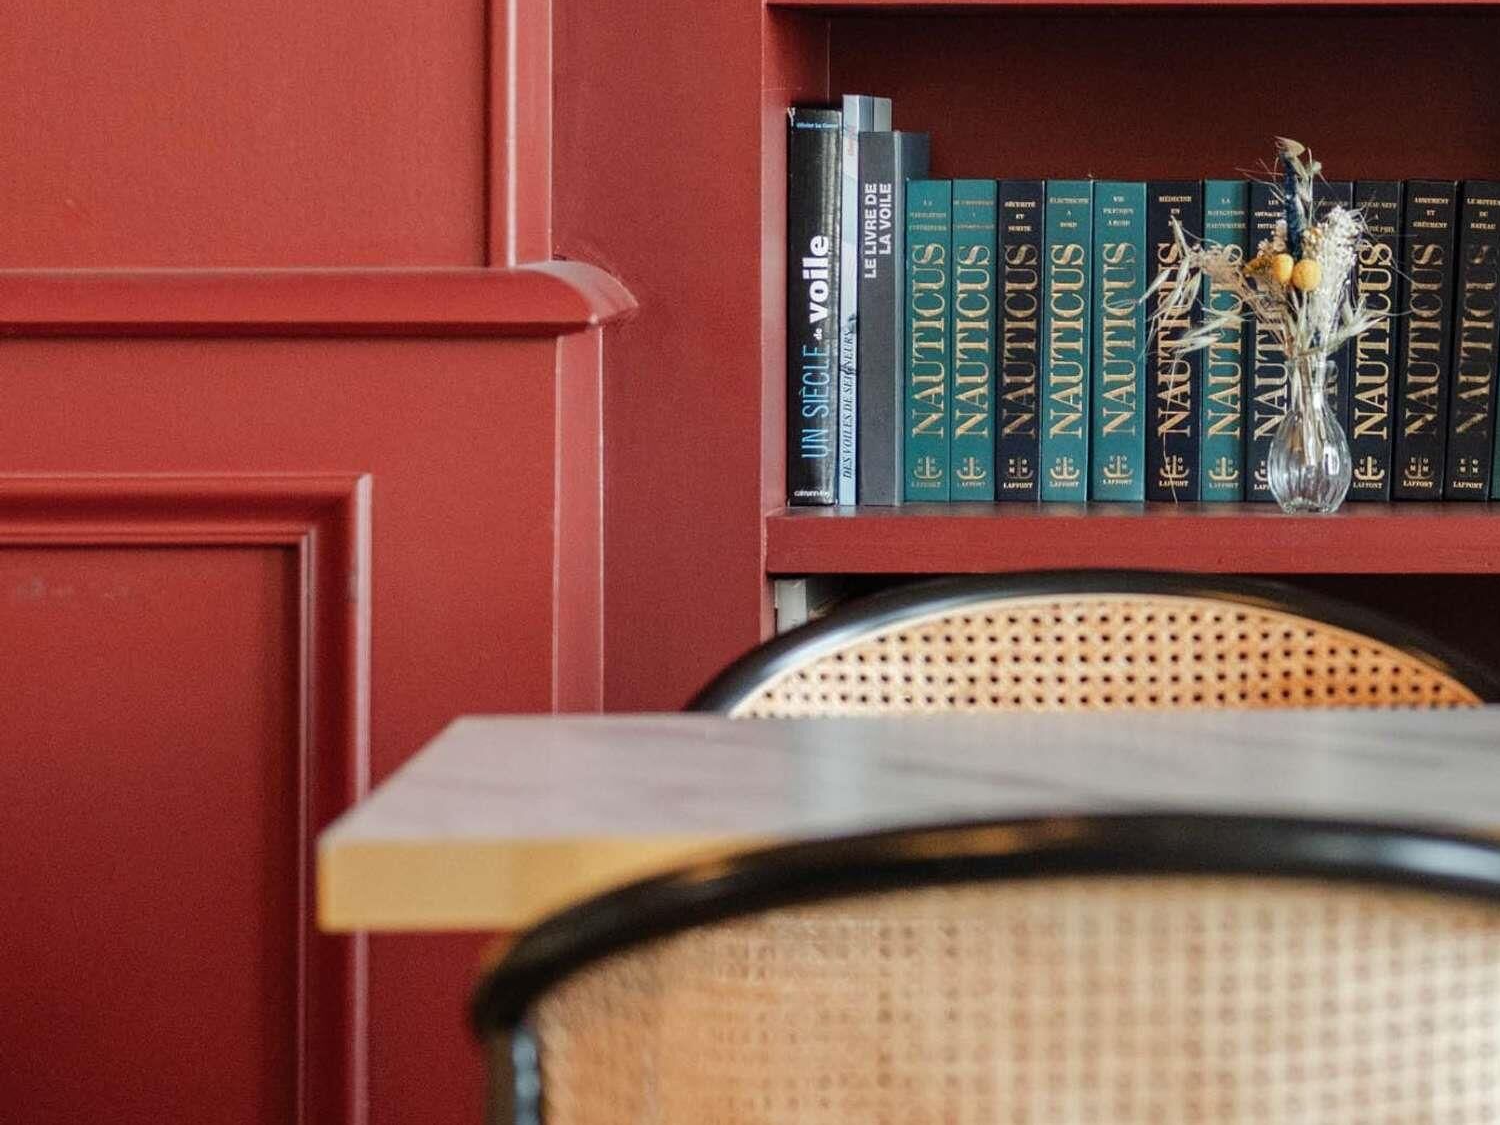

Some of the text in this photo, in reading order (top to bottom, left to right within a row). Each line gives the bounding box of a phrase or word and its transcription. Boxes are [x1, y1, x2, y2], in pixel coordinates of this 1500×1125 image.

[801, 235, 829, 323] voile
[864, 183, 877, 279] LE LIVRE DE
[878, 183, 892, 255] LA VOILE
[799, 344, 831, 418] SIÈCLE
[813, 327, 823, 340] de
[911, 242, 946, 439] NAUTICUS
[954, 244, 991, 439] NAUTICUS
[1001, 243, 1039, 439] NAUTICUS
[1049, 242, 1085, 439] NAUTICUS
[1102, 242, 1137, 437] NAUTICUS
[1353, 242, 1393, 441] NAUTICUS
[1404, 243, 1444, 437] NAUTICUS
[1455, 244, 1498, 436] NAUTICUS
[801, 427, 830, 459] UN
[842, 412, 854, 453] VOILES
[842, 457, 854, 479] DES
